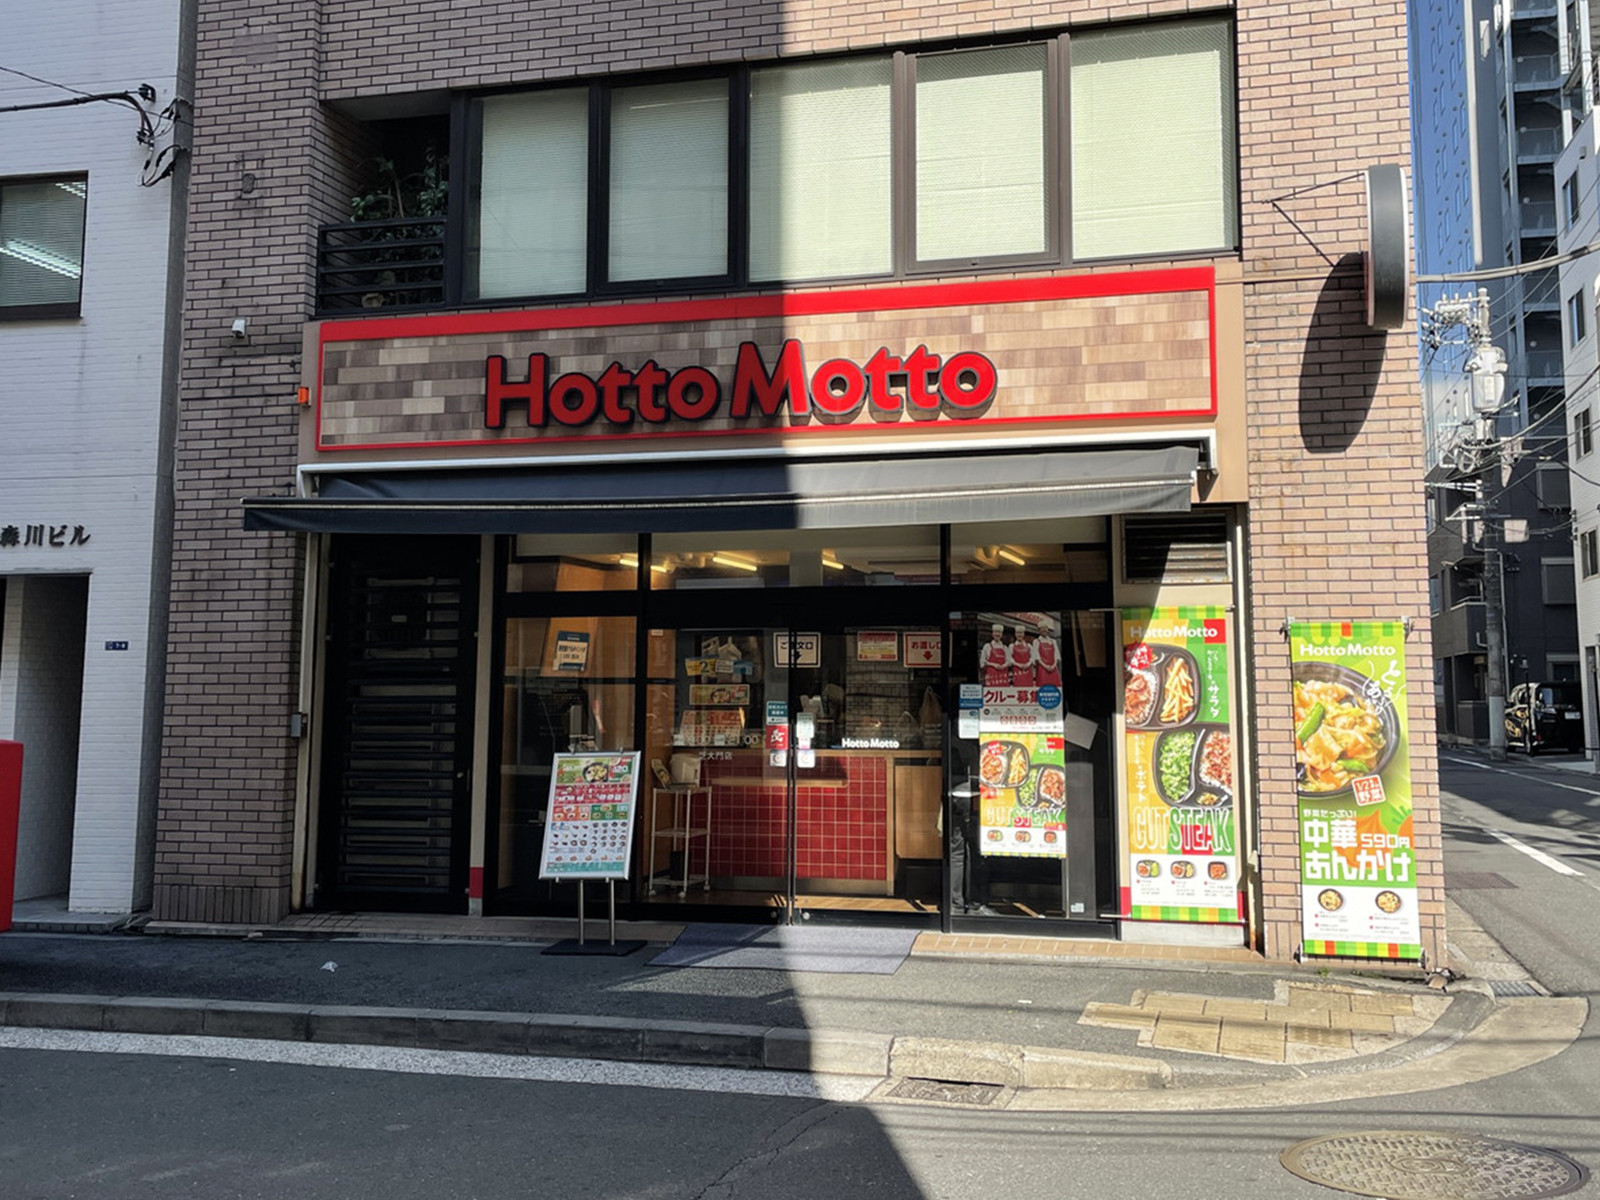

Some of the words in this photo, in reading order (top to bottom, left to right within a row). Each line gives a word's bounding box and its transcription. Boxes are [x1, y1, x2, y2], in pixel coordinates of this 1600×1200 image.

[485, 353, 720, 428] Hotto
[730, 338, 998, 425] Motto
[0, 524, 91, 547] 森川ビル
[1130, 626, 1174, 639] Hotto
[1174, 626, 1218, 638] Motto
[780, 640, 814, 650] ご文口
[1299, 643, 1346, 657] Hotto
[1347, 644, 1396, 657] Motto
[841, 737, 870, 749] Hotto
[870, 737, 900, 749] Motto
[1132, 806, 1169, 850] CUT
[1169, 807, 1232, 853] STEAK
[1303, 818, 1358, 849] 中華
[1360, 833, 1410, 849] 590円
[1305, 849, 1412, 882] あんかけ
